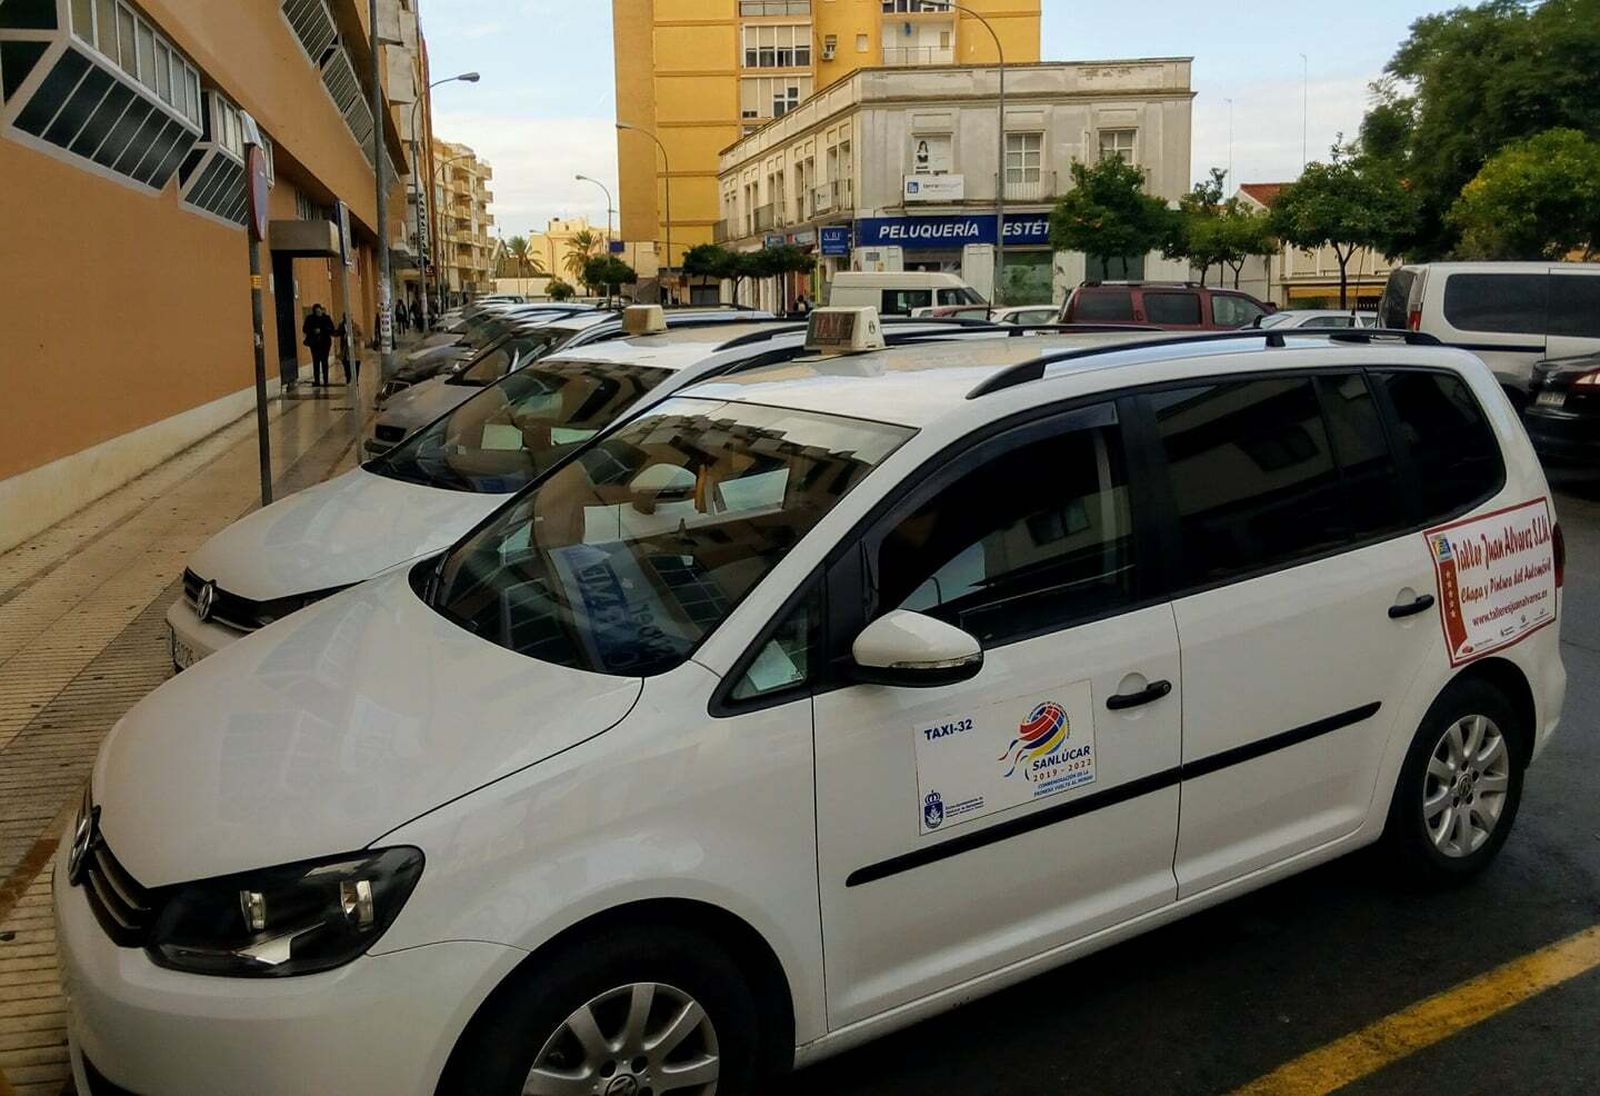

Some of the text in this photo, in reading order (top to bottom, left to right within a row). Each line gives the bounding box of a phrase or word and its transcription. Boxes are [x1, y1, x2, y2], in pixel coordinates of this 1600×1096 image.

[879, 220, 1050, 239] PELUQUERÍA ESTÉT
[1452, 538, 1482, 573] Taller
[1480, 533, 1504, 570] Juan
[1461, 586, 1484, 604] Chapa
[1490, 575, 1512, 593] Pintura
[1514, 567, 1523, 585] del
[924, 718, 973, 741] TAXI-32
[1032, 745, 1091, 772] SANLÚCAR
[1033, 768, 1058, 783] 2019
